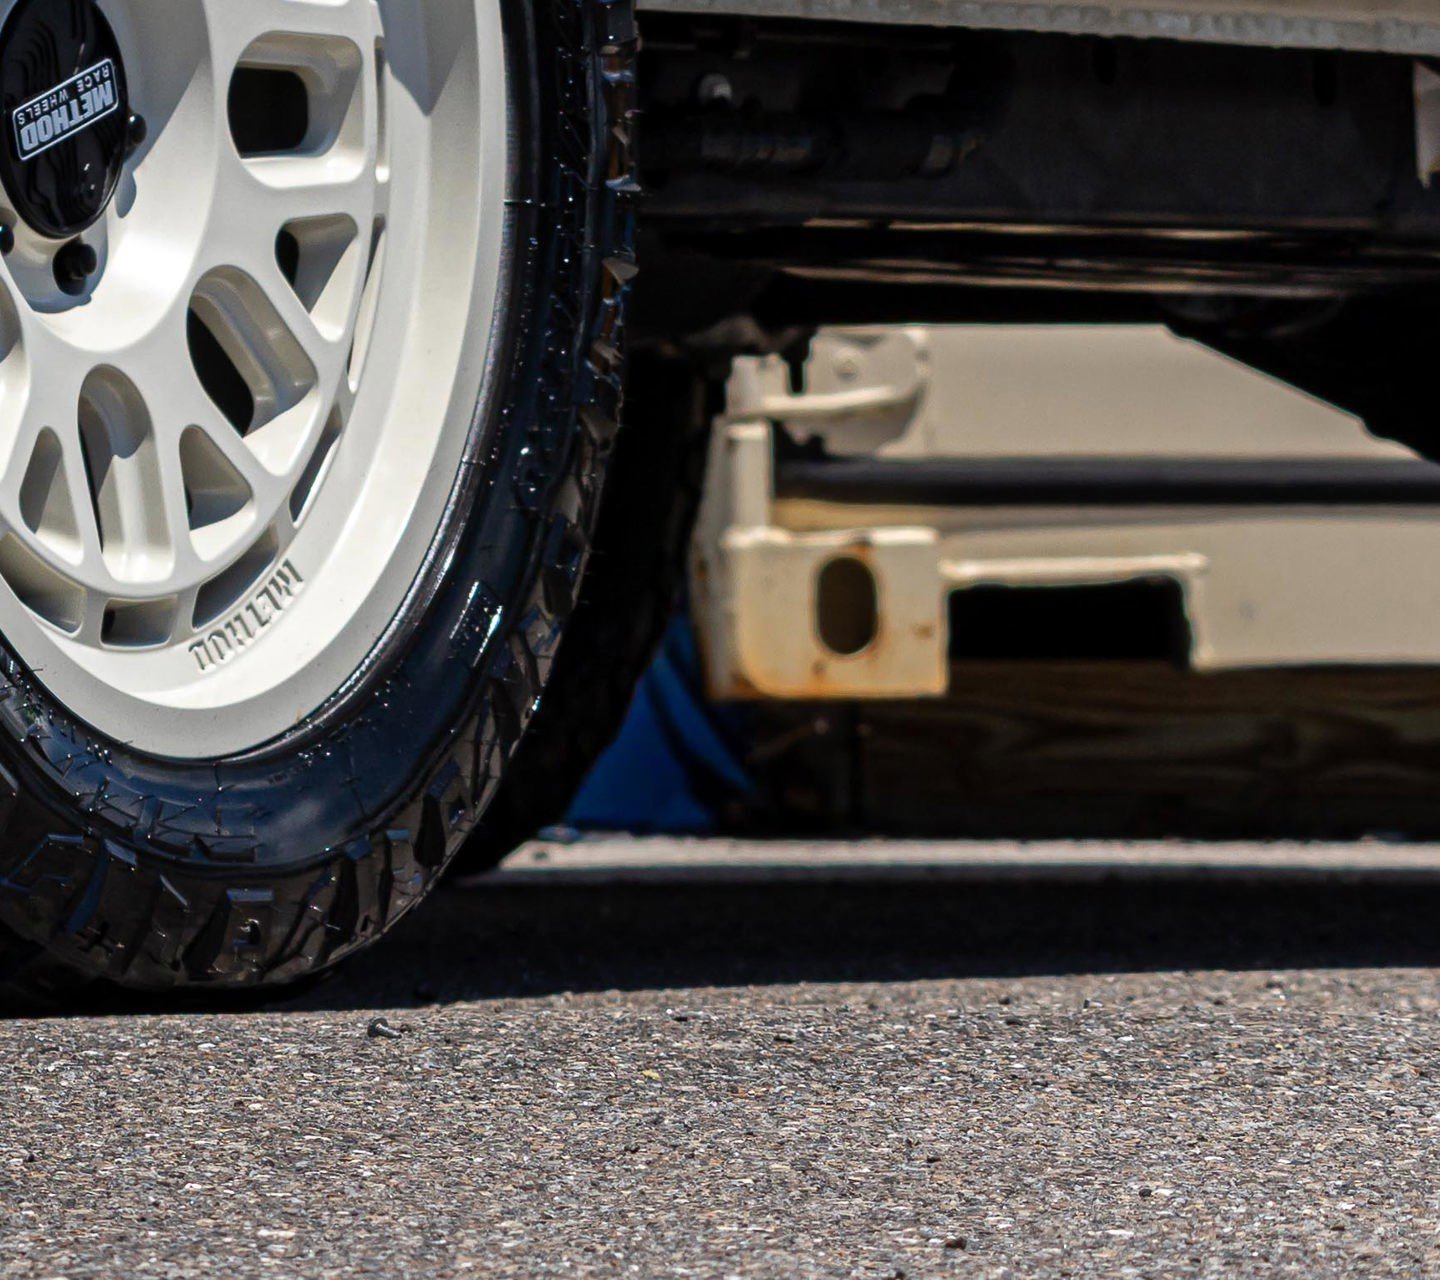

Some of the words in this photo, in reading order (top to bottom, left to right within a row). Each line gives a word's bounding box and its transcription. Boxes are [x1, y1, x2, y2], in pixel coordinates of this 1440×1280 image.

[77, 64, 110, 93] RACE
[16, 90, 69, 125] WHEELS
[19, 79, 115, 152] METHOD
